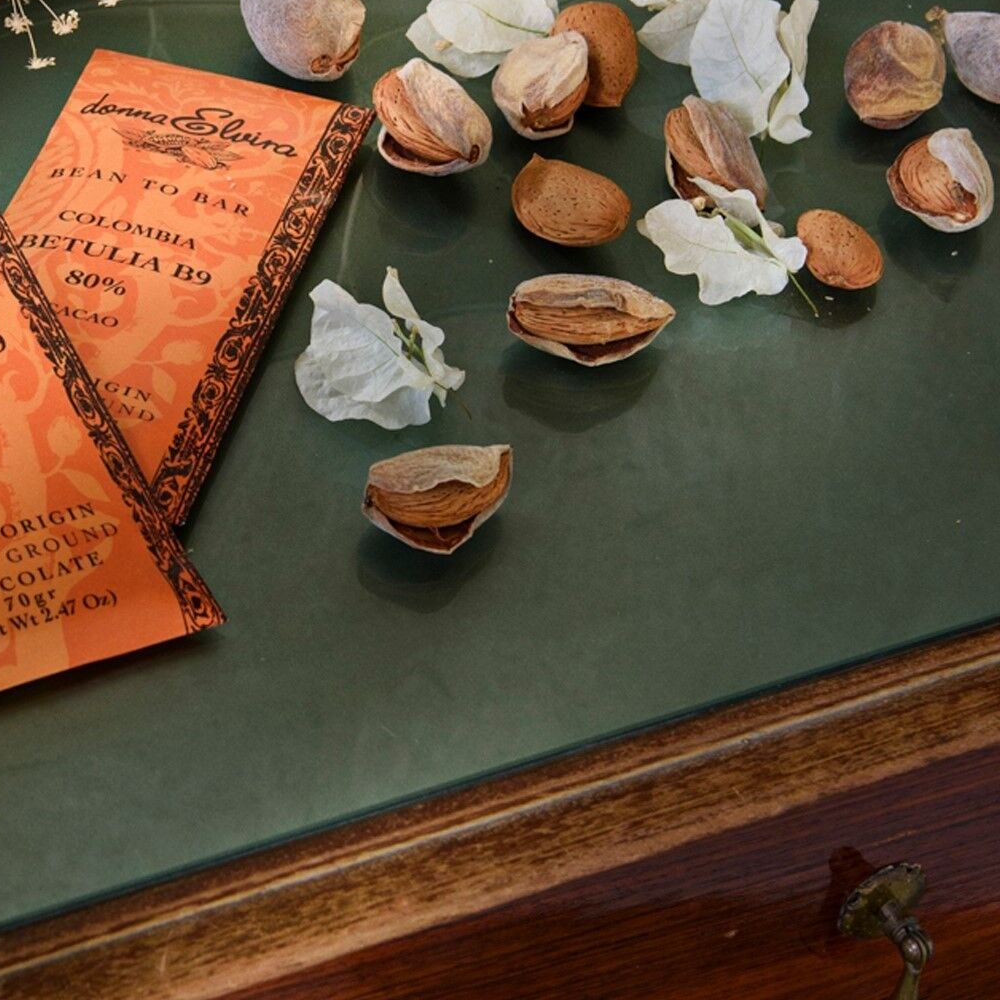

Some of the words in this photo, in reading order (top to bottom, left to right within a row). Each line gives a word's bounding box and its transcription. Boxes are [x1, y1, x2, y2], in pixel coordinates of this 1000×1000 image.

[80, 93, 168, 125] donna
[170, 106, 298, 158] Elvira
[50, 165, 128, 184] BEAN
[142, 177, 179, 196] TO
[192, 191, 250, 218] BAR
[57, 210, 197, 251] COLOMBIA
[17, 233, 163, 274] BETULIA
[171, 261, 213, 285] B9
[64, 269, 127, 297] 80%
[0, 502, 96, 540] ORIGIN
[6, 521, 118, 564] GROUND
[8, 614, 39, 632] Wt
[41, 601, 76, 624] 2.47
[82, 590, 118, 610] Oz)
